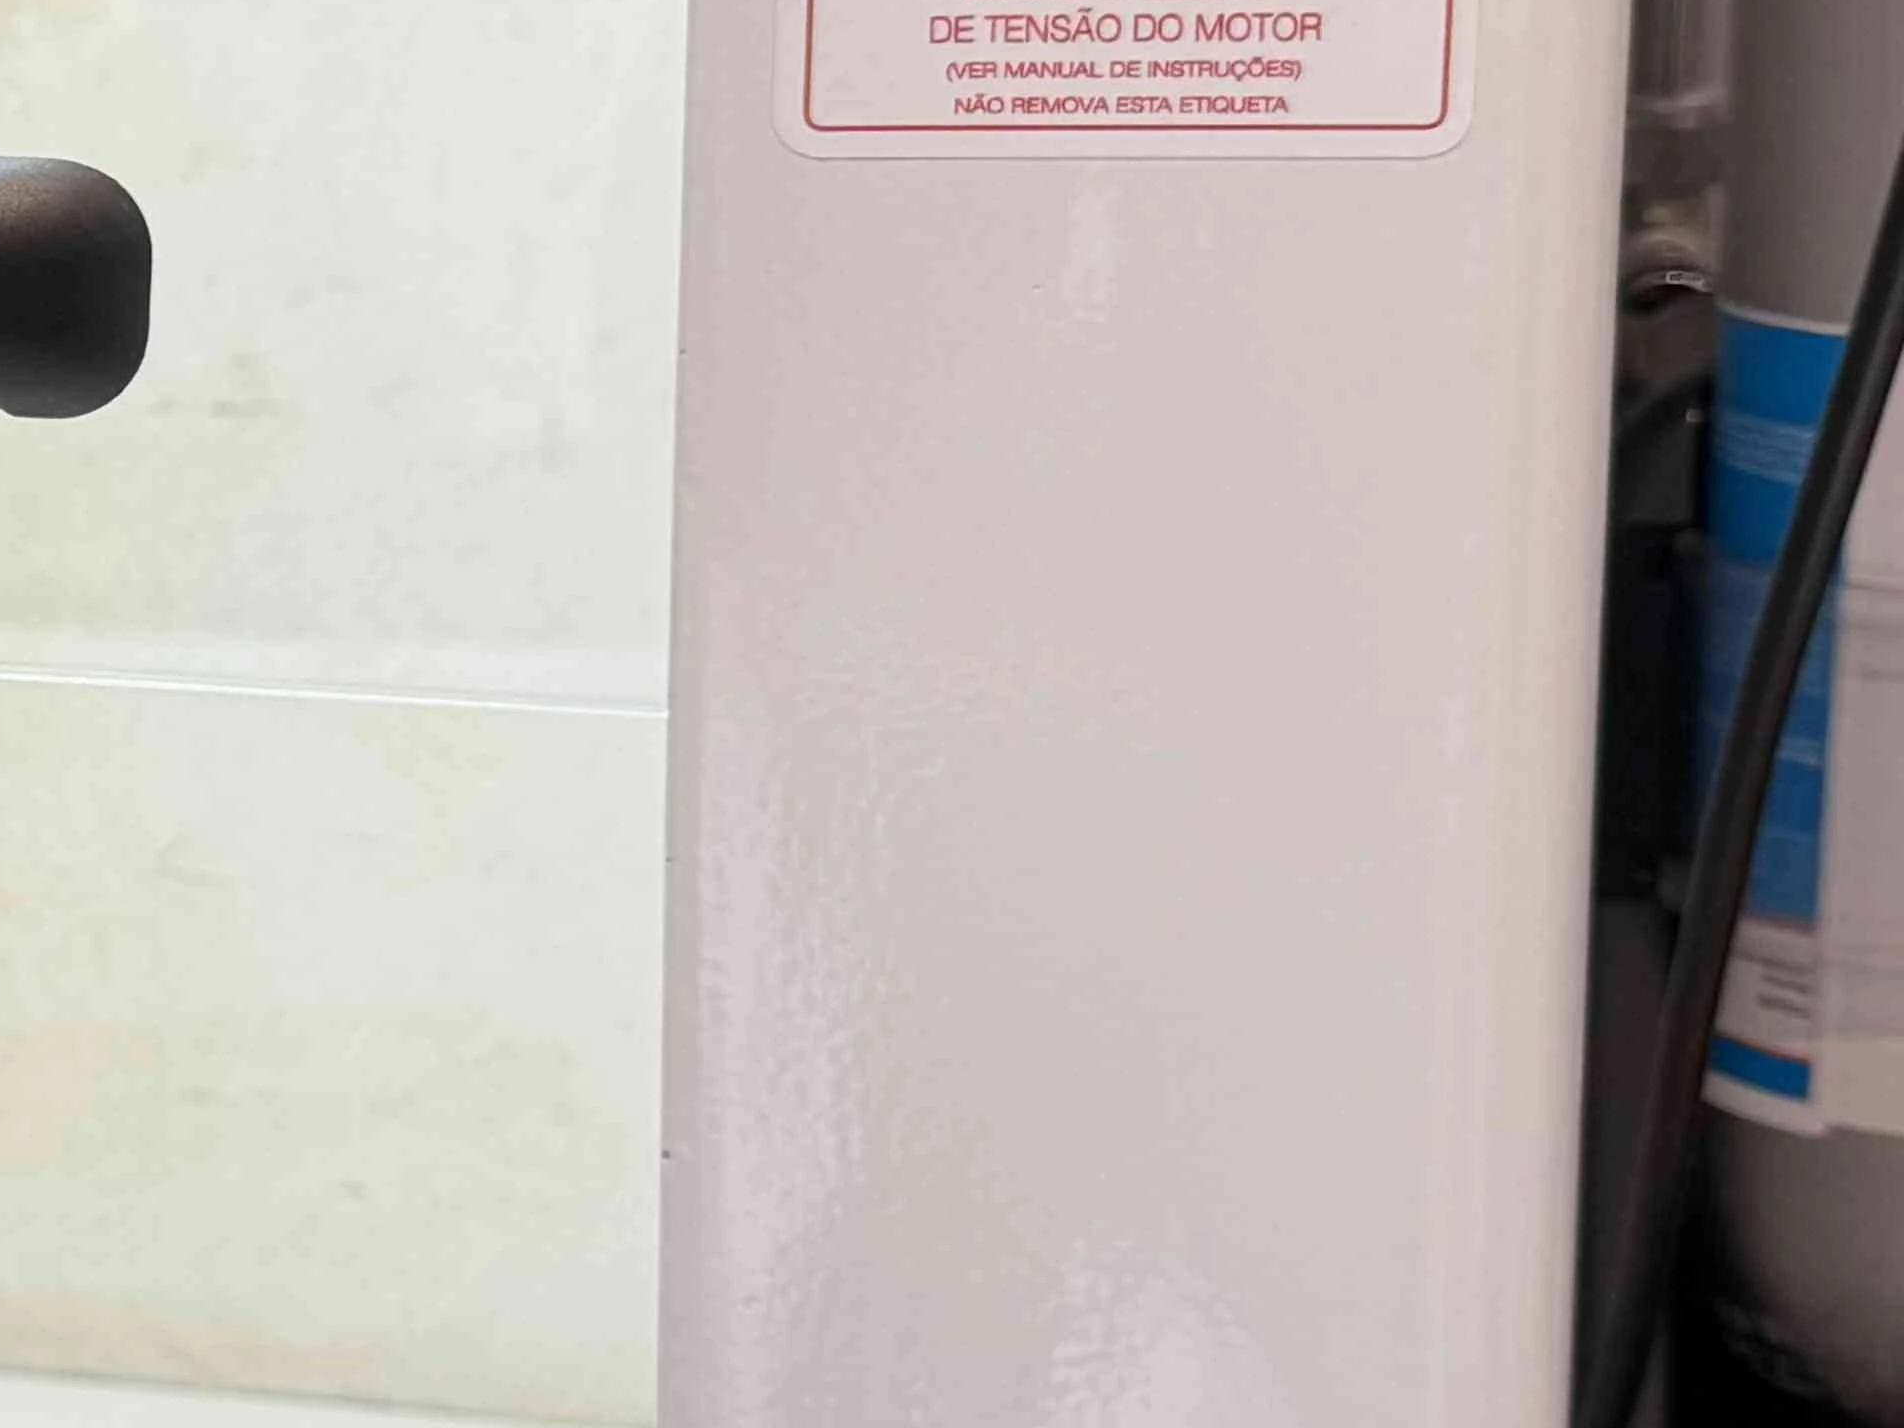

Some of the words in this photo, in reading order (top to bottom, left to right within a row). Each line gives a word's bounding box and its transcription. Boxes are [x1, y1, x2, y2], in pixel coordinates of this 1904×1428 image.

[929, 14, 976, 44] DE
[984, 7, 1122, 43] TENSÃO
[1132, 13, 1184, 43] DO
[1195, 12, 1323, 42] MOTOR
[946, 60, 998, 82] (VER
[1004, 60, 1104, 79] MANUAL
[1110, 60, 1142, 78] DE
[1147, 56, 1302, 82] INSTRUÇÕES)
[954, 93, 1005, 114] NÃO
[1011, 96, 1110, 114] REMOVA
[1116, 96, 1173, 114] ESTA
[1179, 95, 1289, 114] ETIQUETA
